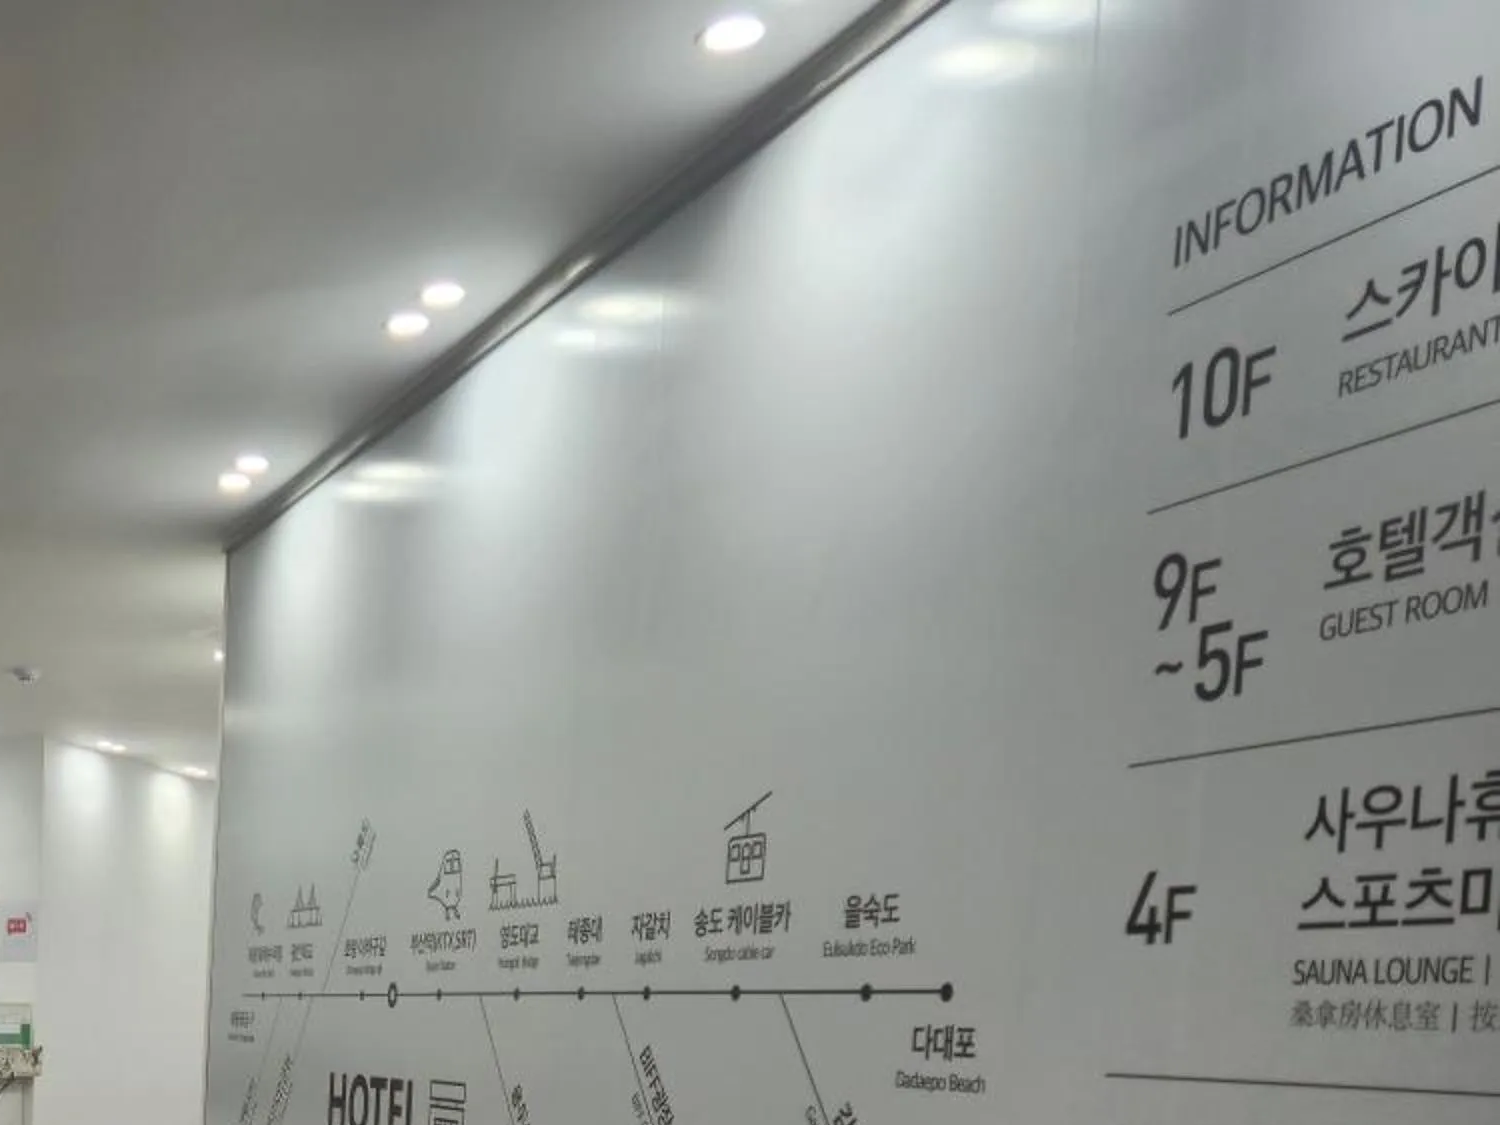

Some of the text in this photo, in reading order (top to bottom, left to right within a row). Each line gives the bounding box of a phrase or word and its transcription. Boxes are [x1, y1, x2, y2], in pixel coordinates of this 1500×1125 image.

[1173, 75, 1483, 269] INFORMATION
[1338, 314, 1500, 398] RESTAURANT
[1171, 345, 1277, 440] 10F
[1153, 552, 1222, 631] 9F
[1319, 579, 1489, 641] GUEST ROOM
[693, 899, 793, 938] 송도 케이블카
[844, 893, 901, 929] 을숙도
[1124, 870, 1198, 945] 4F
[1292, 956, 1475, 986] SAUNA LOUNGE
[911, 1023, 977, 1061] 다대포
